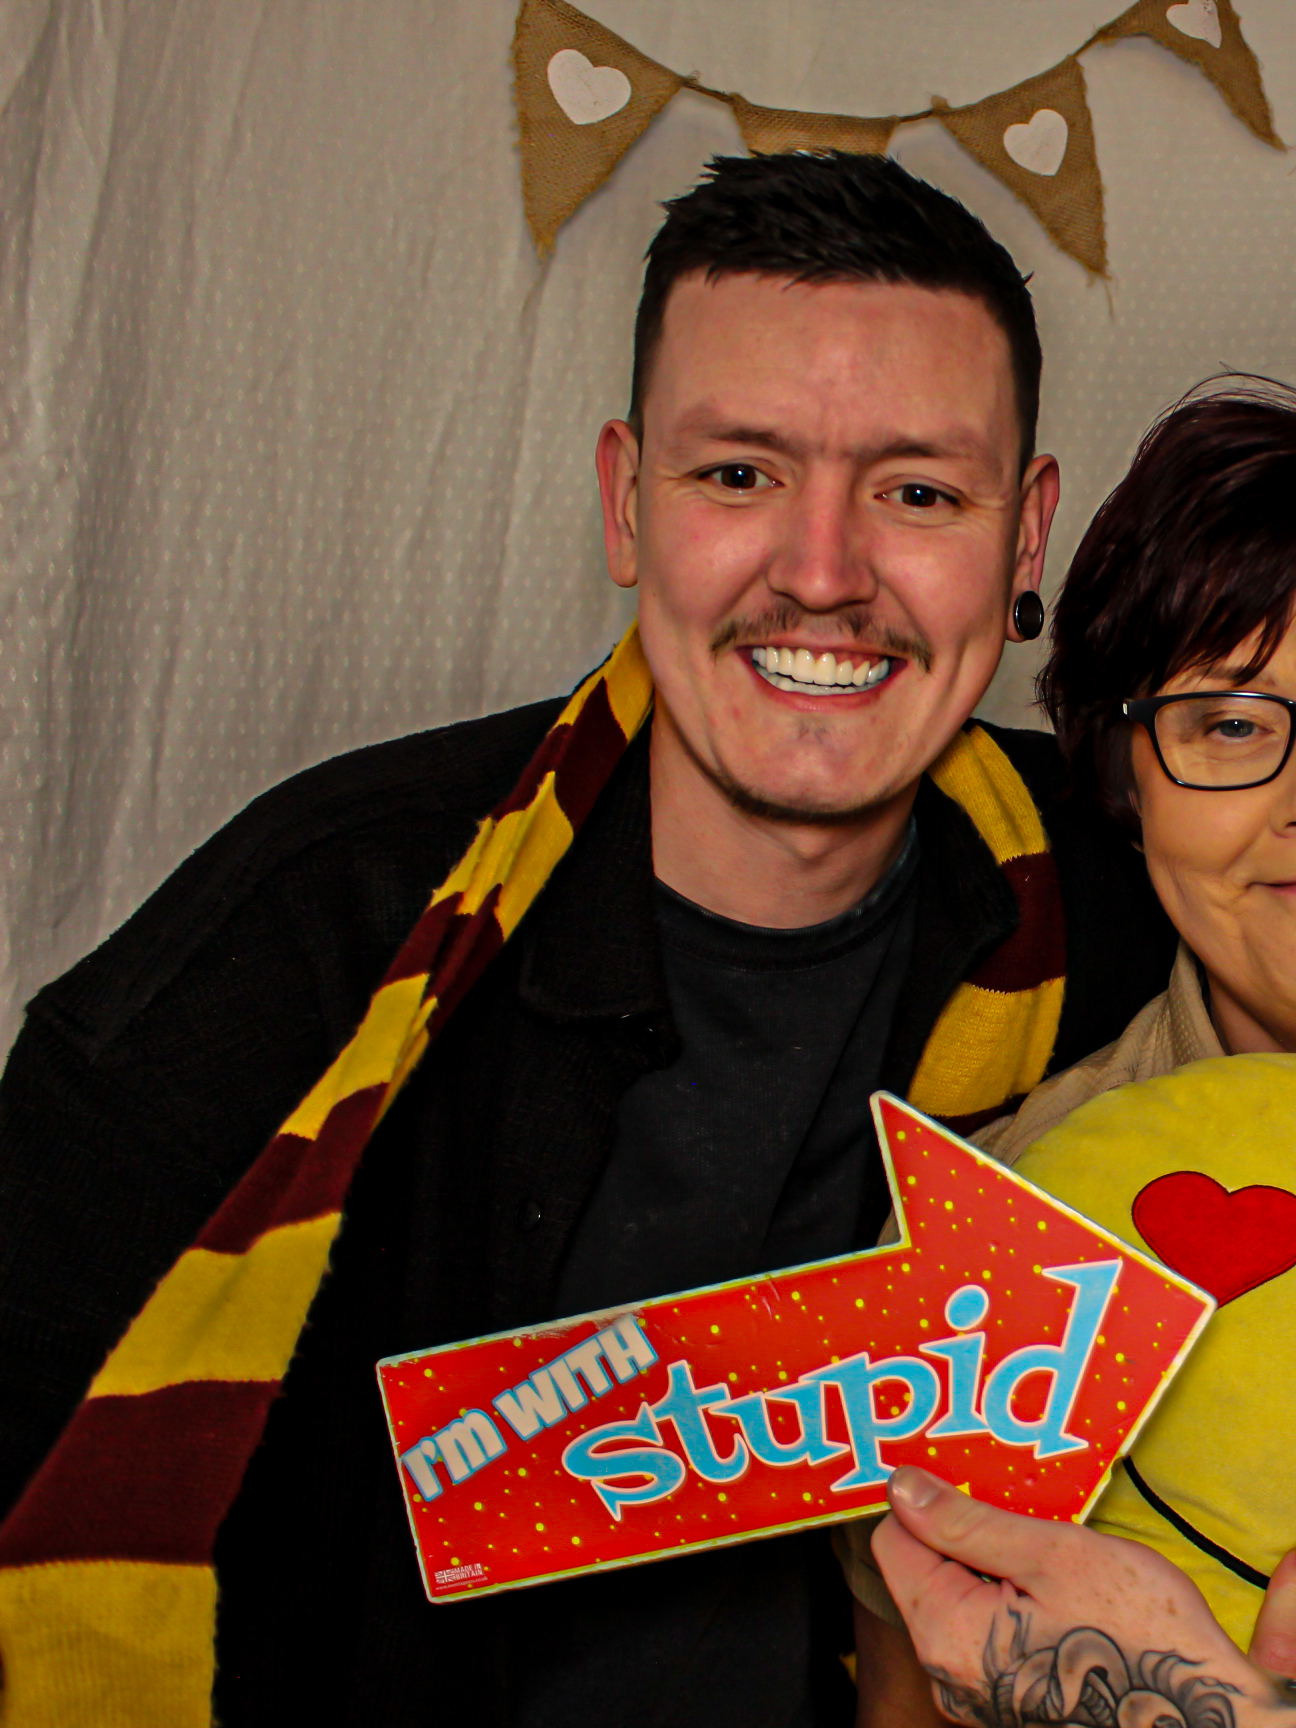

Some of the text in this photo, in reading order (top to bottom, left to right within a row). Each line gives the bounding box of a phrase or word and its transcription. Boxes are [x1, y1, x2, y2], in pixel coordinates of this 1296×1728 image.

[492, 1313, 659, 1442] WITH
[561, 1259, 1122, 1521] stupid
[453, 1562, 483, 1575] MADE IN
[455, 1569, 483, 1580] BRITAIN
